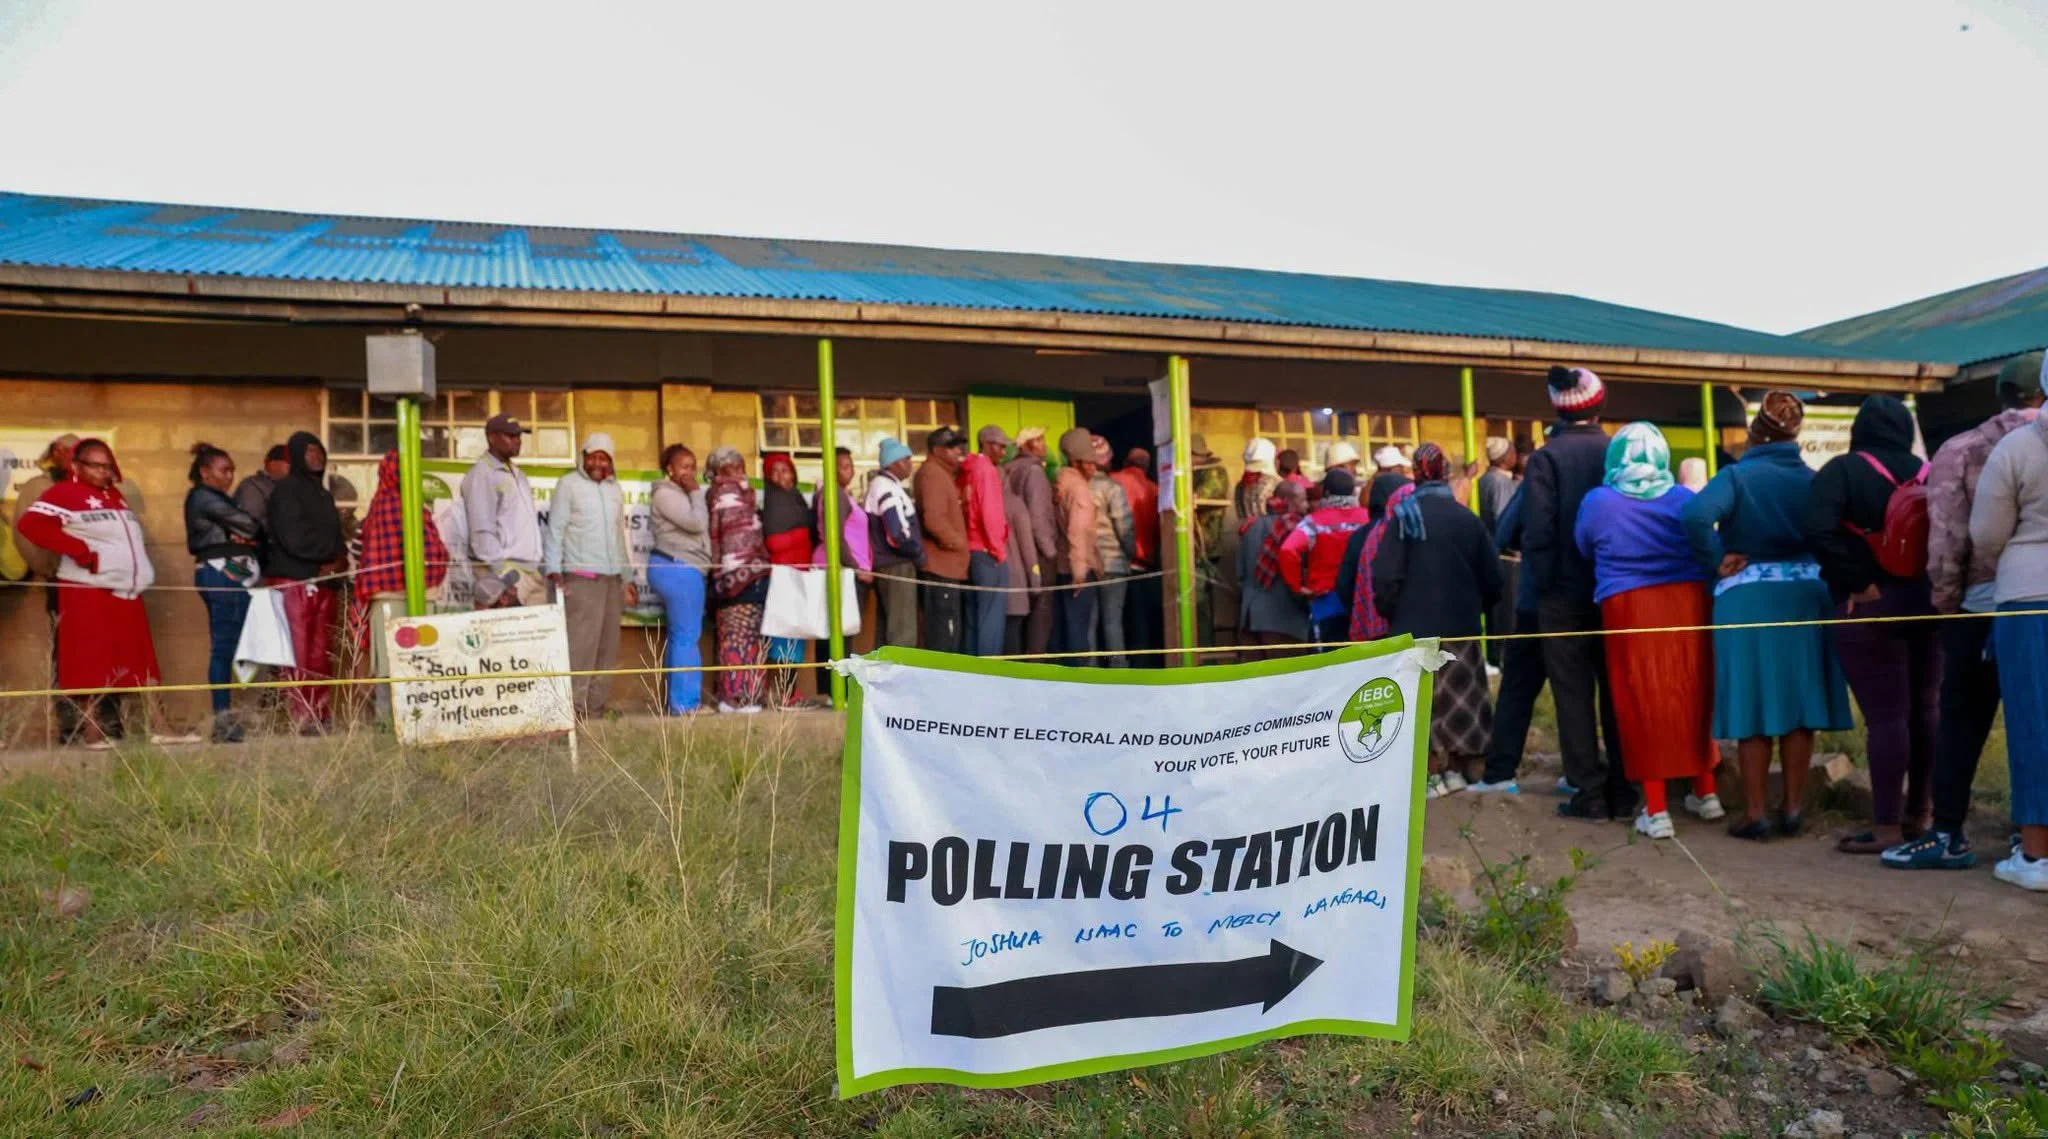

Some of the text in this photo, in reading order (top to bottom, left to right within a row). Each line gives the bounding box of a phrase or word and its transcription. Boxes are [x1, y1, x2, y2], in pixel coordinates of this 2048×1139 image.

[480, 657, 503, 673] No
[510, 655, 529, 671] to
[406, 679, 535, 708] negative peer
[1359, 684, 1394, 703] IEBC
[886, 709, 1333, 746] INDEPENDENT ELECTORAL AND BOUNDARIES COMMISSION
[1153, 735, 1330, 773] YOUR VOTE, YOUR FUTURE
[886, 803, 1380, 907] POLLING STATION
[961, 929, 1043, 967] JOSHUA
[1207, 910, 1281, 935] MERCY
